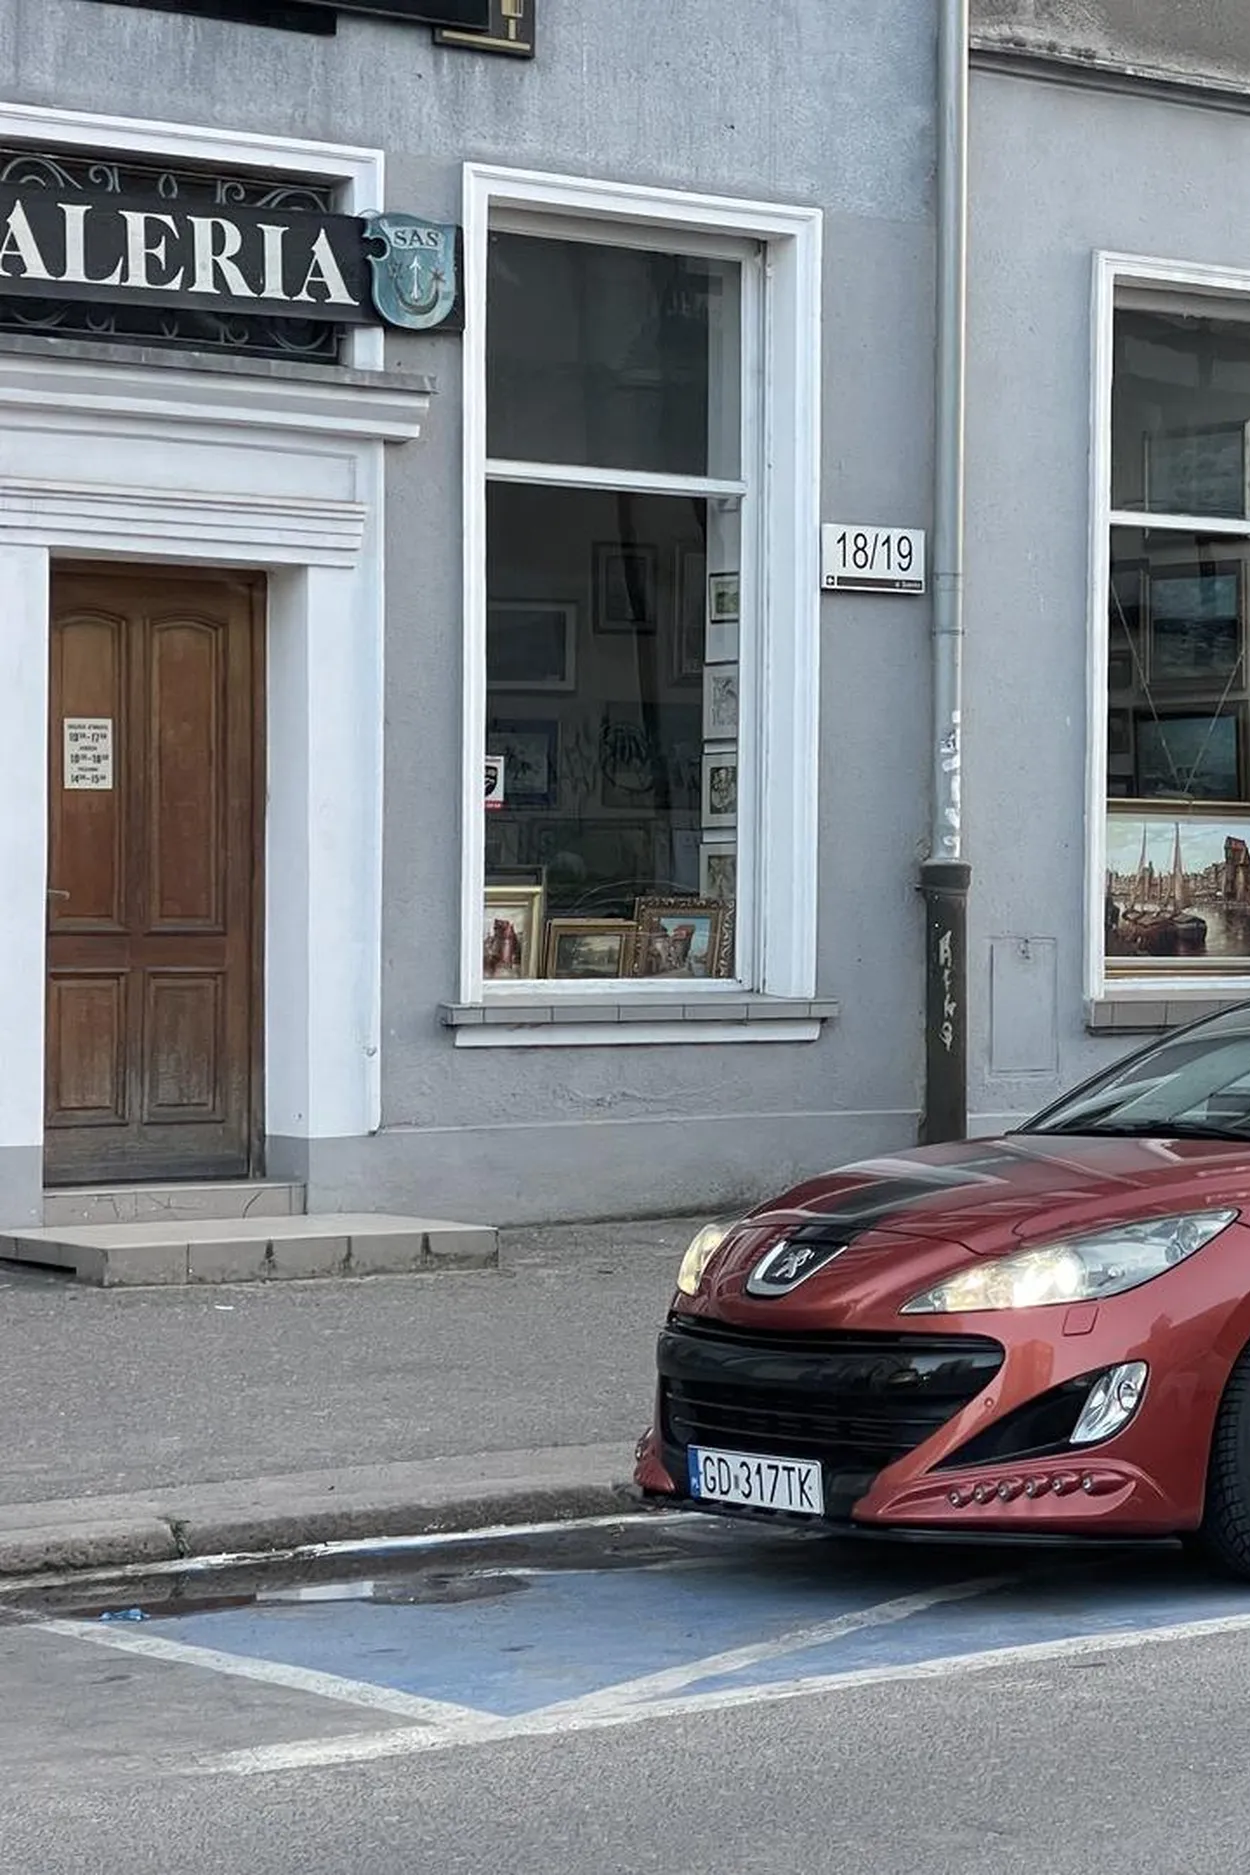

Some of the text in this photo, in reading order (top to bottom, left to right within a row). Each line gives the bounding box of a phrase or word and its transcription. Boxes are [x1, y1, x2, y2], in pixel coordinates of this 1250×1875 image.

[0, 199, 359, 306] ALERIA
[394, 229, 440, 247] SAS
[836, 531, 912, 571] 18/19
[703, 1456, 731, 1495] GD
[739, 1461, 813, 1508] 317TK
